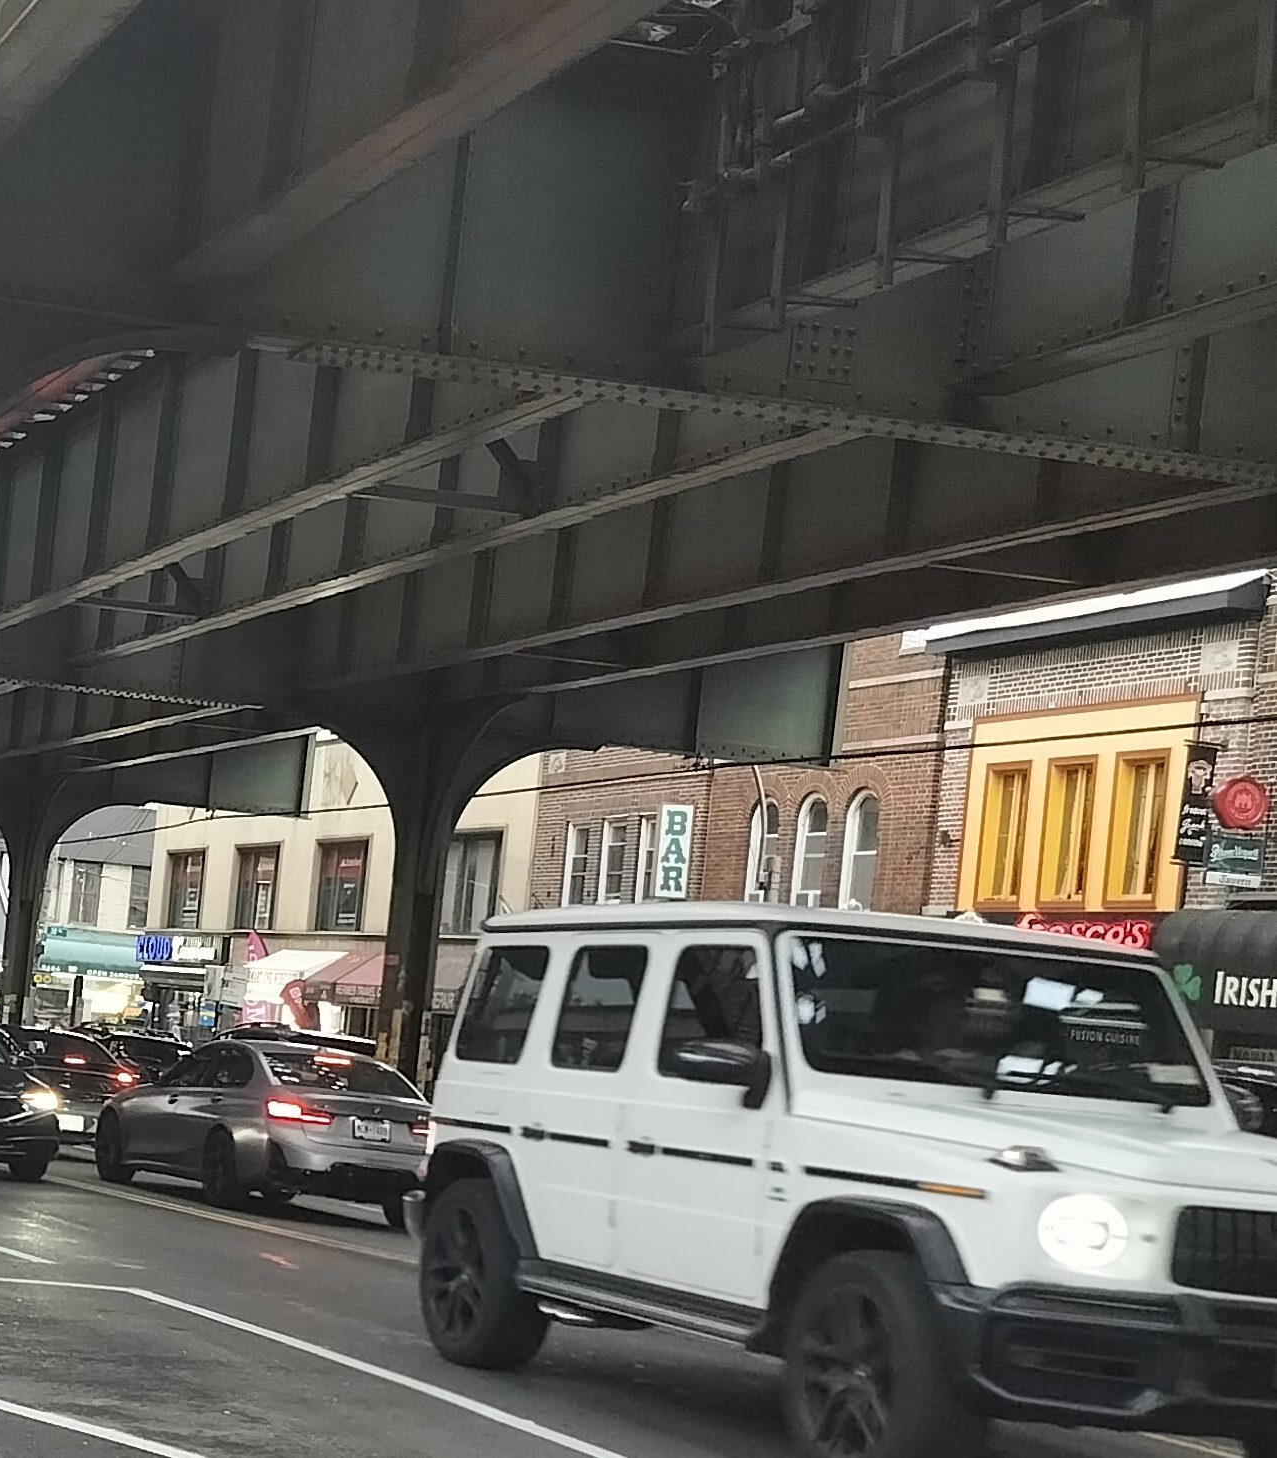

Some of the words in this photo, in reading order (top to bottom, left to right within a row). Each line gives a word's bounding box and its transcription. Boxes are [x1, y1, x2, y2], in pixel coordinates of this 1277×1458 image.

[659, 809, 688, 892] BAR
[1218, 874, 1252, 886] Tavern
[138, 936, 171, 961] CLOUD
[1214, 970, 1277, 1008] IRISH
[1070, 1029, 1103, 1042] FUSION
[1105, 1032, 1141, 1046] CUISINE
